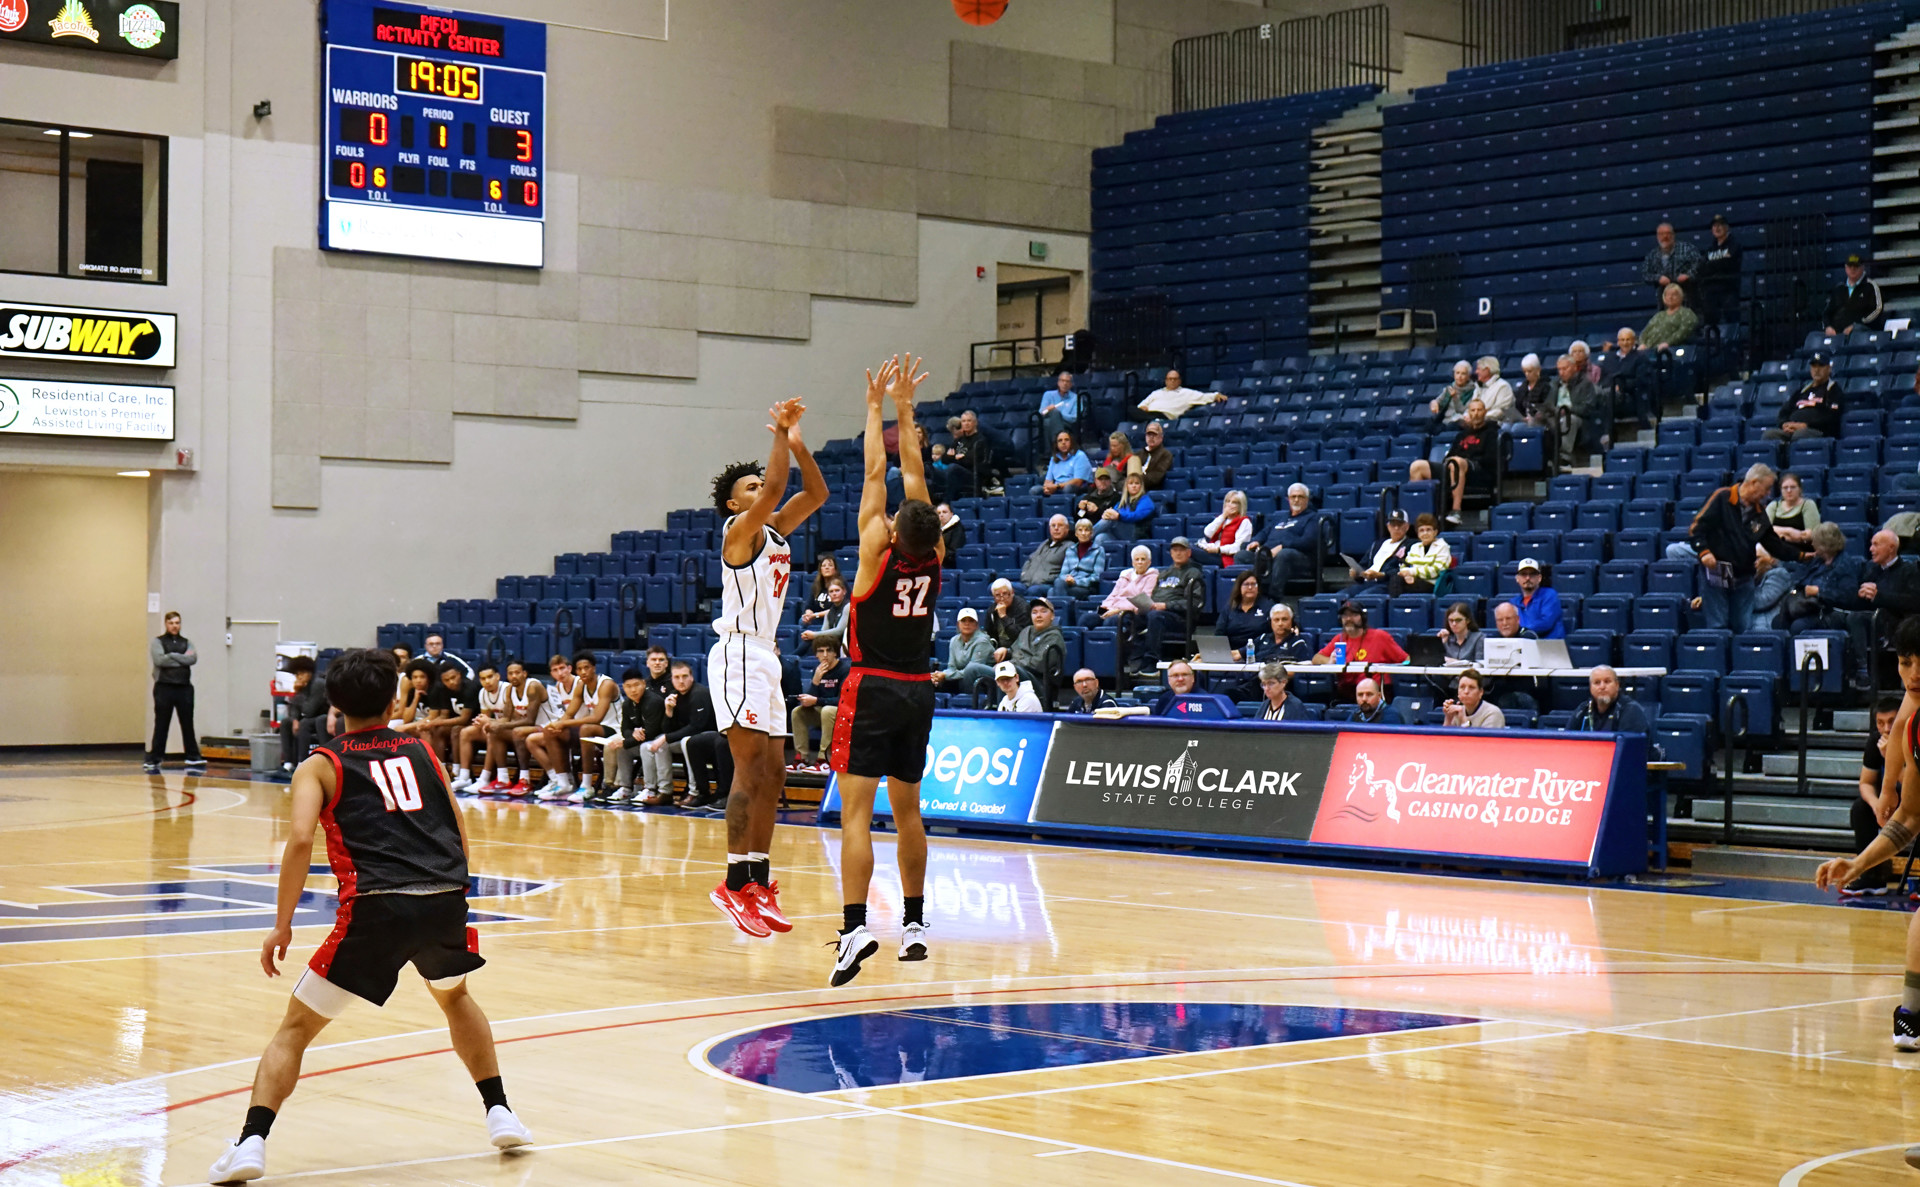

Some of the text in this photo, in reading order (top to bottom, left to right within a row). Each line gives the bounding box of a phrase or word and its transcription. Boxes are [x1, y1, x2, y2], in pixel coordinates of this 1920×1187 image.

[50, 20, 99, 38] TacoTime
[420, 15, 458, 34] PIFCU
[377, 24, 500, 56] ACTIVITY CENTER
[410, 61, 479, 99] 19:05
[332, 88, 398, 110] WARRIORS
[422, 107, 454, 121] PERIOD
[490, 108, 530, 125] GUEST
[369, 113, 388, 145] 0
[438, 125, 447, 148] 1
[335, 145, 365, 158] FOULS
[516, 130, 532, 162] 3
[398, 152, 420, 165] PLYR
[428, 155, 450, 168] FOUL
[459, 159, 476, 171] PTS
[350, 162, 365, 188] 0
[373, 167, 386, 188] 6
[510, 164, 537, 178] FOULS
[367, 190, 391, 202] T.O.L.
[489, 180, 502, 200] 6
[523, 181, 538, 206] 0
[484, 202, 507, 214] T.O.L.
[1479, 297, 1491, 315] D
[0, 314, 154, 355] SUBWAY
[1065, 334, 1075, 350] E
[32, 388, 104, 402] Residential
[145, 394, 167, 406] Inc.
[44, 405, 156, 420] Lewiston's Premier
[32, 416, 167, 434] Assisted Living Facility
[893, 575, 931, 617] 32
[1188, 702, 1202, 713] POSS
[368, 755, 424, 812] 10
[1065, 761, 1302, 796] LEWIS CLARK
[1395, 762, 1601, 806] Clearwater River
[931, 799, 959, 811] Owned
[960, 801, 966, 811] &
[969, 802, 1006, 814] Operated
[1102, 792, 1254, 810] STATE COLLEGE
[1408, 799, 1573, 827] CASINO & LODGE
